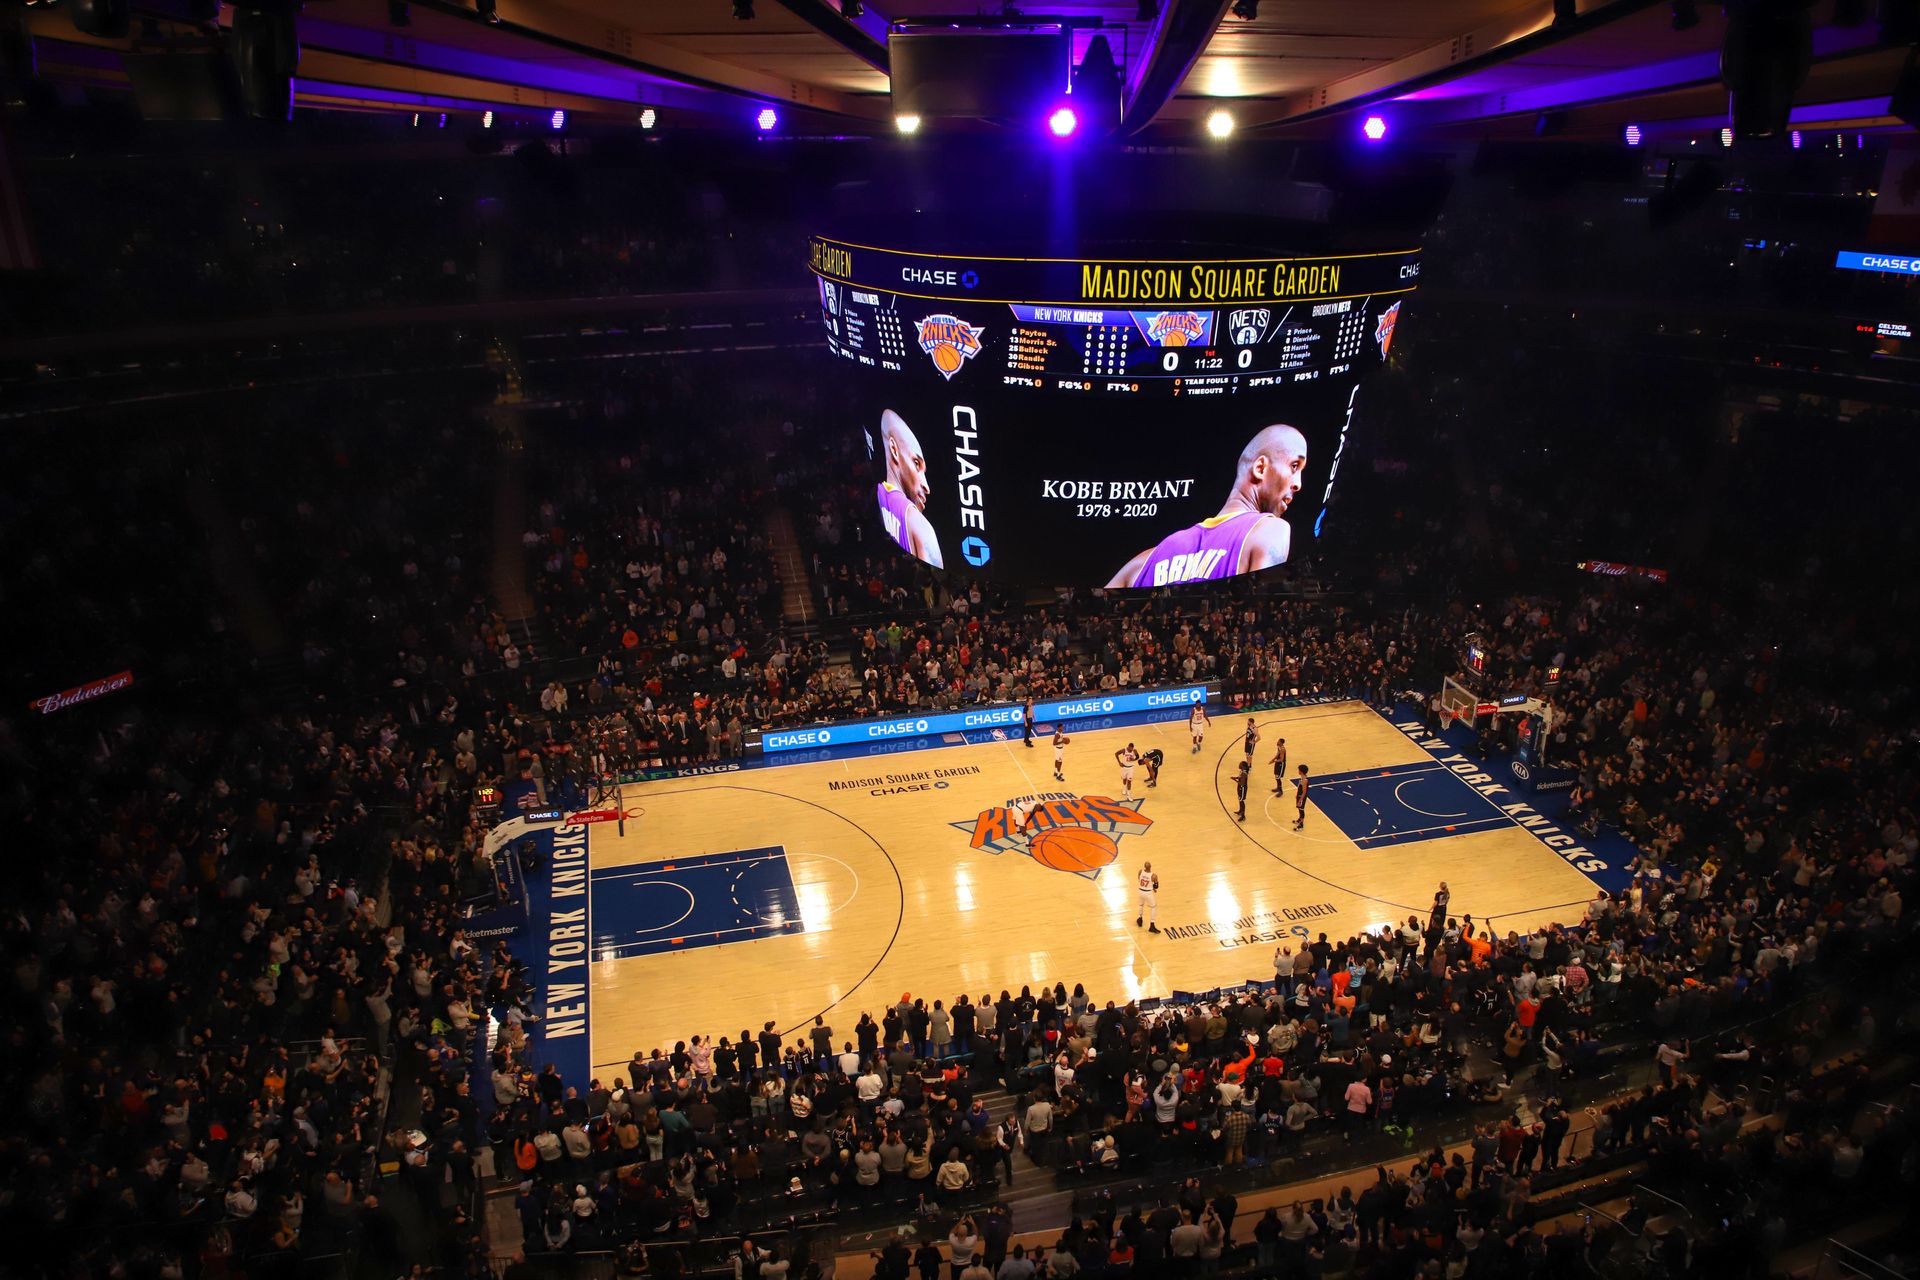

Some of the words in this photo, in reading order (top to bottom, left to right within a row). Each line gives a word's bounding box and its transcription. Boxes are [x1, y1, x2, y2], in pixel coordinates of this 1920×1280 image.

[822, 242, 852, 279] GARDEN
[1862, 256, 1909, 270] CHASE
[902, 267, 957, 286] CHASE
[1081, 264, 1182, 299] MADISON
[1189, 265, 1268, 301] SQUARE
[1273, 263, 1341, 296] GARDEN
[1035, 308, 1052, 320] NEW
[1053, 309, 1072, 322] YORK
[1074, 311, 1103, 323] KNICKS
[1312, 303, 1339, 317] BROOKLYN
[1338, 301, 1351, 313] NETS
[1151, 314, 1201, 334] KNICKS
[1231, 310, 1267, 330] NETS
[1878, 323, 1907, 331] CELTICS
[921, 321, 979, 349] KNICKS
[1020, 329, 1047, 337] Payton
[1292, 335, 1320, 343] Dinwiddie
[1877, 329, 1911, 337] PELICANS
[1019, 346, 1048, 354] Bullock
[1019, 354, 1045, 362] Randle
[1163, 352, 1179, 371] 0
[1195, 358, 1223, 369] 11:22
[1238, 349, 1252, 368] 0
[1249, 377, 1274, 386] 3PT%
[1276, 376, 1281, 384] 0
[1295, 372, 1311, 381] FG%
[1330, 366, 1344, 375] FT%
[1004, 377, 1033, 386] 3PT%
[1035, 379, 1042, 387] 0
[1059, 381, 1082, 389] FG%
[1084, 382, 1091, 390] 0
[1107, 383, 1130, 391] FT%
[1131, 384, 1139, 392] 0
[952, 405, 985, 531] CHASE
[1042, 480, 1104, 500] KOBE
[1109, 479, 1194, 500] BRYANT
[1076, 504, 1111, 517] 1978
[1123, 503, 1158, 517] 2020
[36, 676, 128, 714] Budweiser
[1148, 692, 1188, 706] CHASE
[1058, 702, 1100, 715] CHASE
[965, 711, 1009, 726] CHASE
[869, 722, 914, 736] CHASE
[769, 733, 816, 747] CHASE
[829, 777, 883, 791] MADISON
[886, 771, 930, 784] SQUARE
[934, 766, 980, 779] GARDEN
[870, 783, 931, 797] CHASE
[1037, 792, 1078, 801] YORK
[1396, 721, 1451, 750] NEW
[1440, 753, 1511, 796] YORK
[1502, 802, 1608, 873] KNICKS
[551, 823, 586, 898] KNICKS
[1140, 879, 1150, 888] 67
[1282, 903, 1338, 921] GARDEN
[464, 927, 516, 939] icketmaster
[1220, 929, 1290, 948] CHASE
[548, 908, 586, 974] YORK
[545, 984, 586, 1040] NEW
